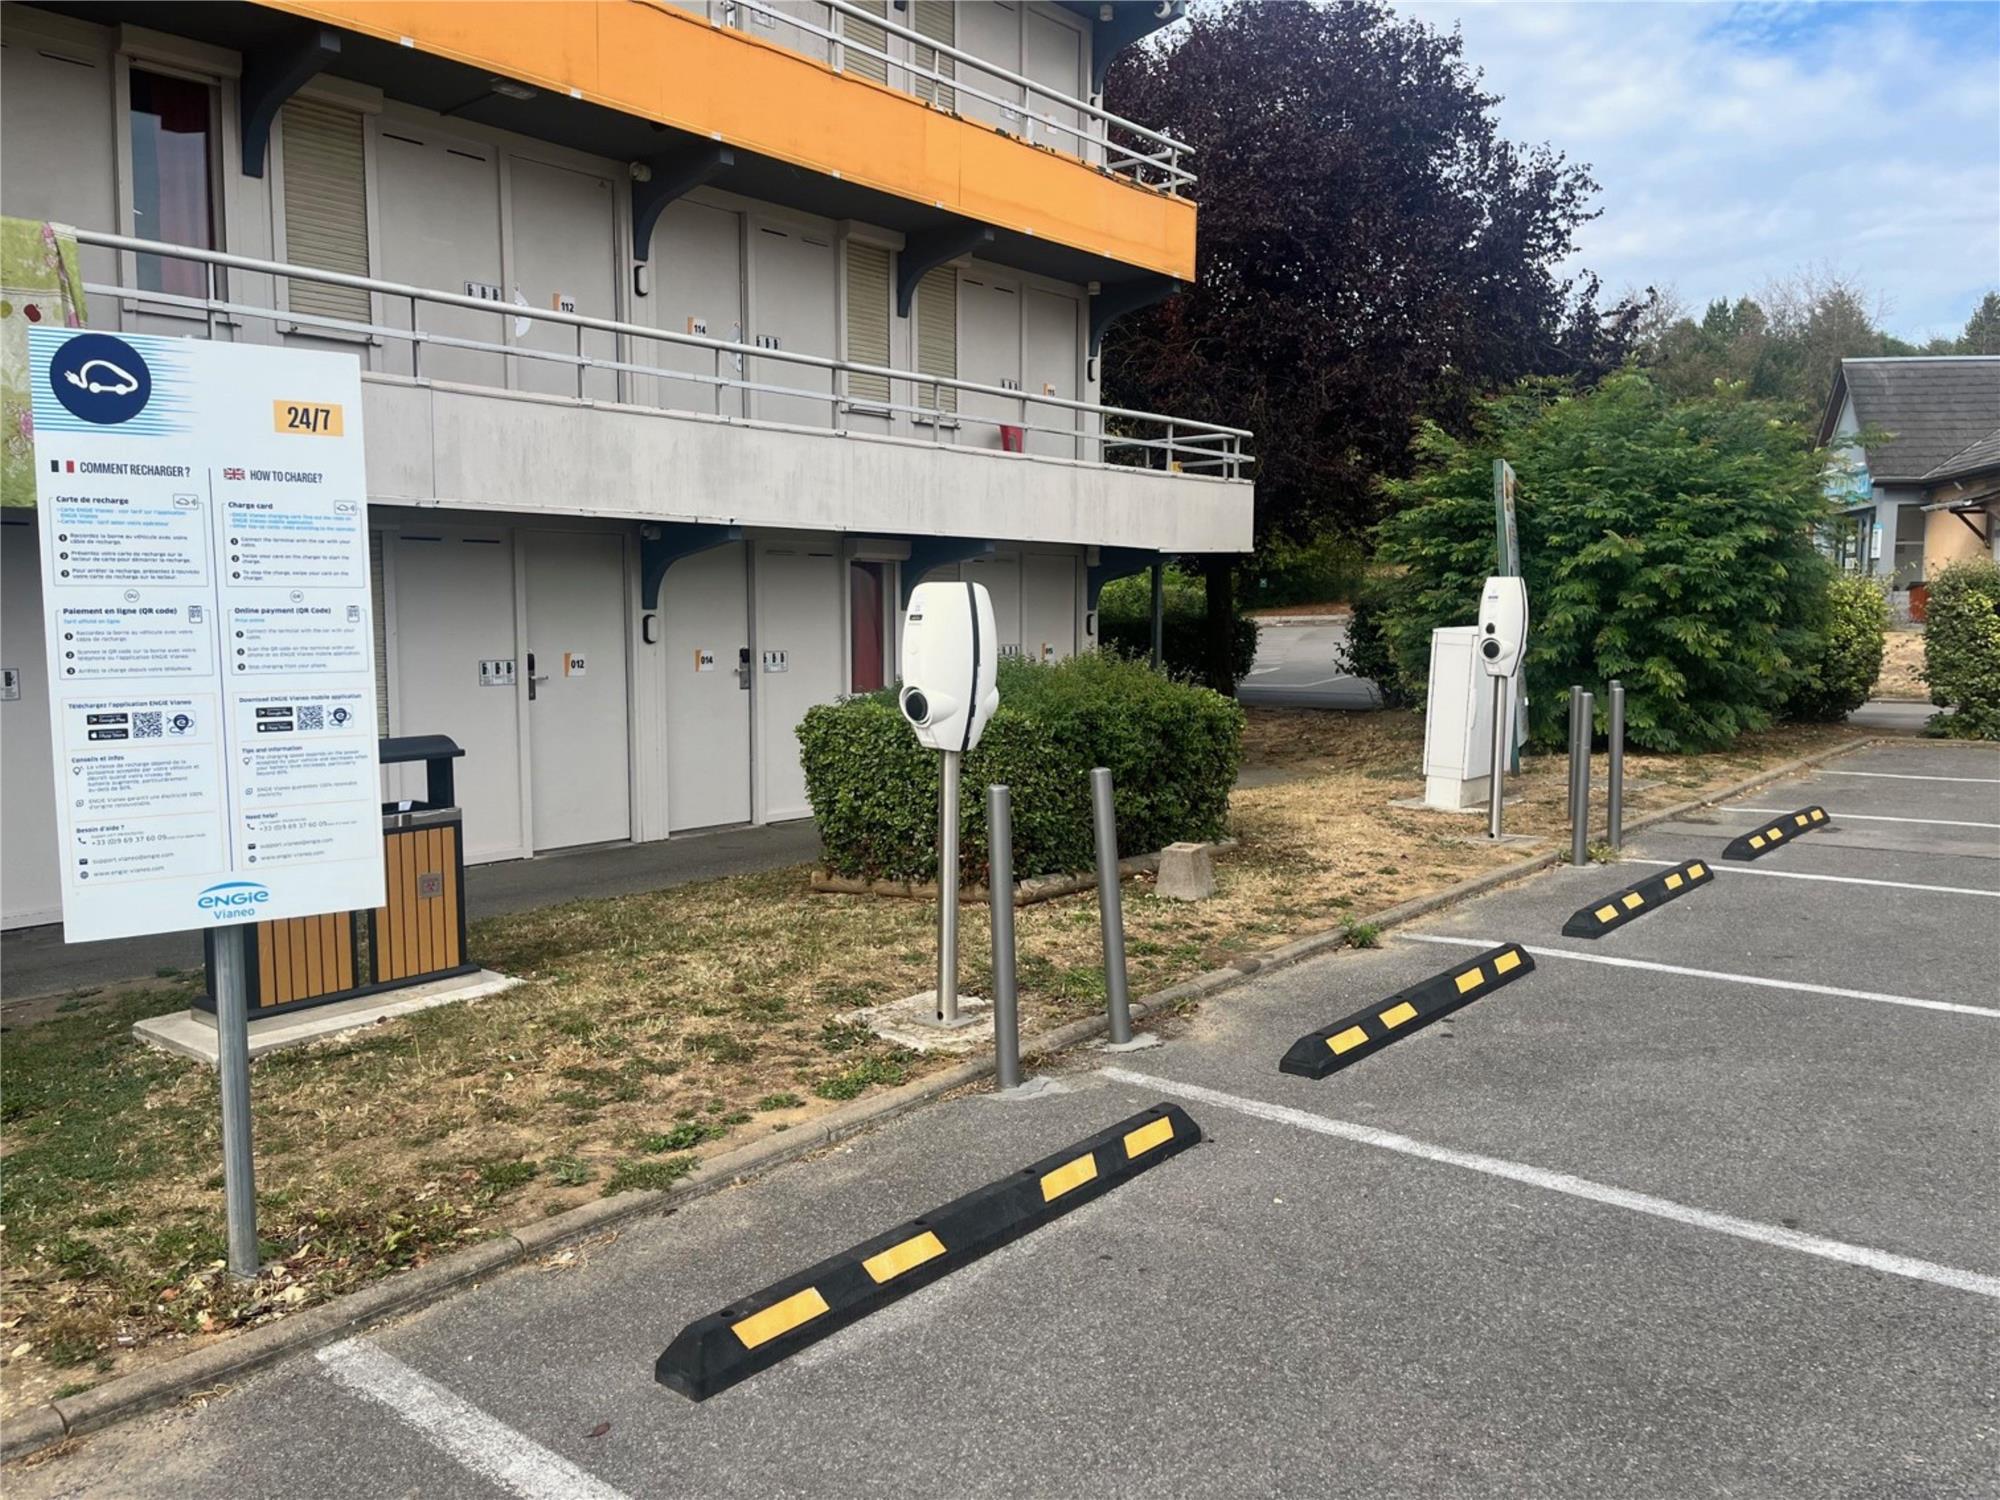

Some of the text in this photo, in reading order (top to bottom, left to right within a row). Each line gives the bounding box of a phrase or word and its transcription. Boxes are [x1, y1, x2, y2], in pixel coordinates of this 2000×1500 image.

[561, 302, 574, 313] 112
[286, 406, 331, 433] 24/7
[80, 462, 190, 477] COMMENT RECHARGER ?
[250, 470, 322, 484] HOW TO CHARGE?
[56, 496, 79, 504] Carte
[92, 497, 129, 506] recharge
[228, 501, 256, 510] Charge
[116, 607, 137, 616] ligne
[138, 607, 154, 615] (QR
[155, 607, 178, 615] code)
[261, 607, 294, 615] payment
[296, 607, 309, 615] (QR
[310, 607, 331, 615] Code)
[570, 660, 584, 669] 012
[214, 908, 255, 920] Vianeo
